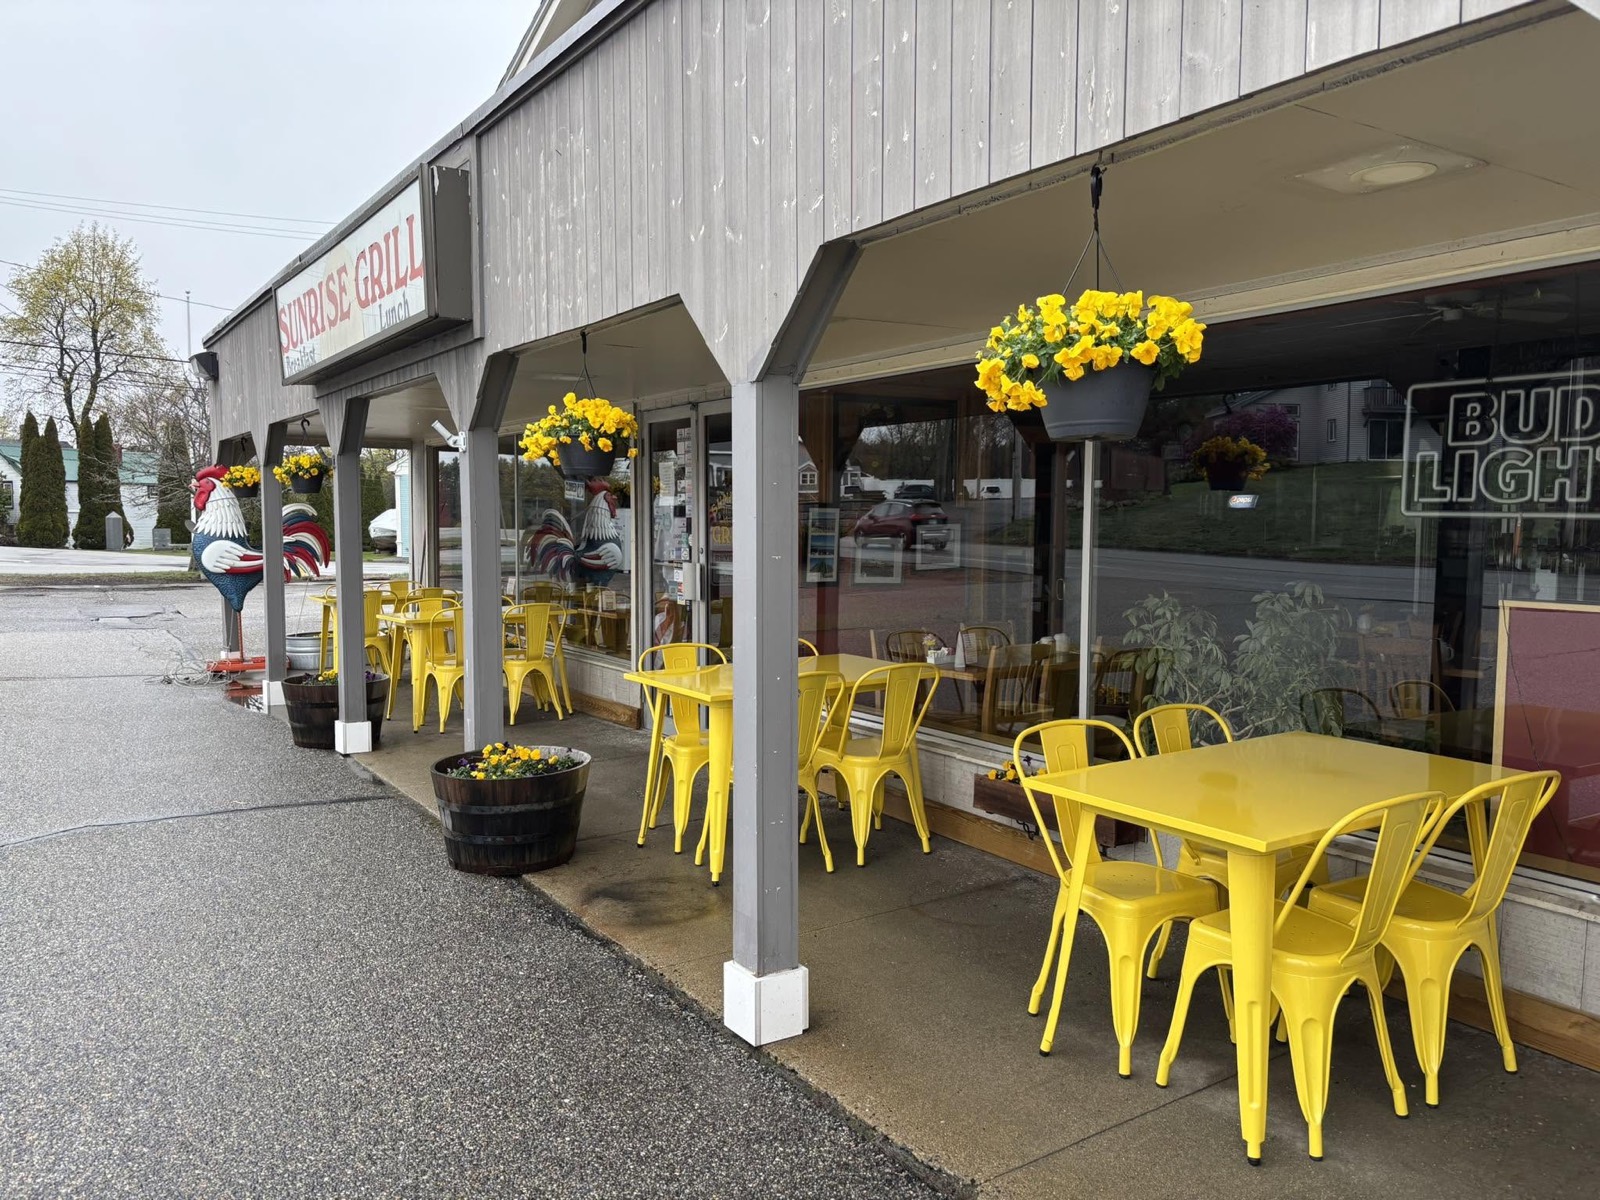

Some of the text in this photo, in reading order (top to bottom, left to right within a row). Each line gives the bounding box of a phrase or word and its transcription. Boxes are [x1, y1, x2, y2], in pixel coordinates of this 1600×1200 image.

[278, 213, 424, 354] SUNRISE GRILL
[378, 291, 410, 330] Lunch
[1447, 384, 1600, 446] BUD
[1414, 447, 1600, 503] LIGH
